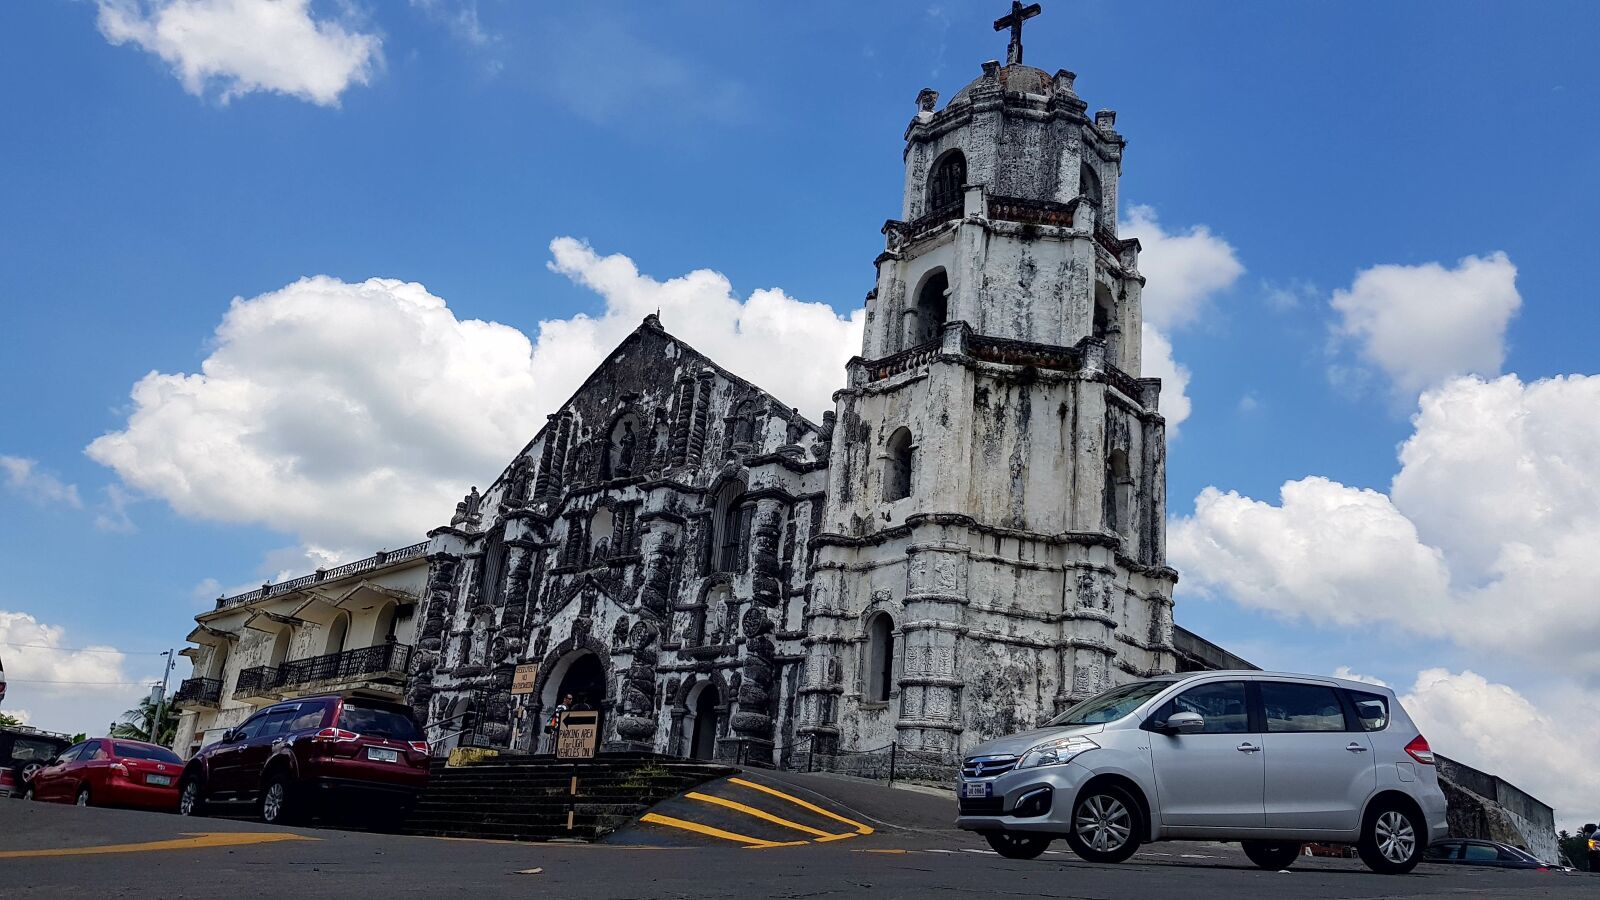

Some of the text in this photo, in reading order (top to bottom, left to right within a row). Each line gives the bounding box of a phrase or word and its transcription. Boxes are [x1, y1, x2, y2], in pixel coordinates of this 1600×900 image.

[560, 729, 593, 738] PARKING AREA
[572, 738, 585, 748] LIGHT
[558, 747, 595, 757] VEHICLES ONLY
